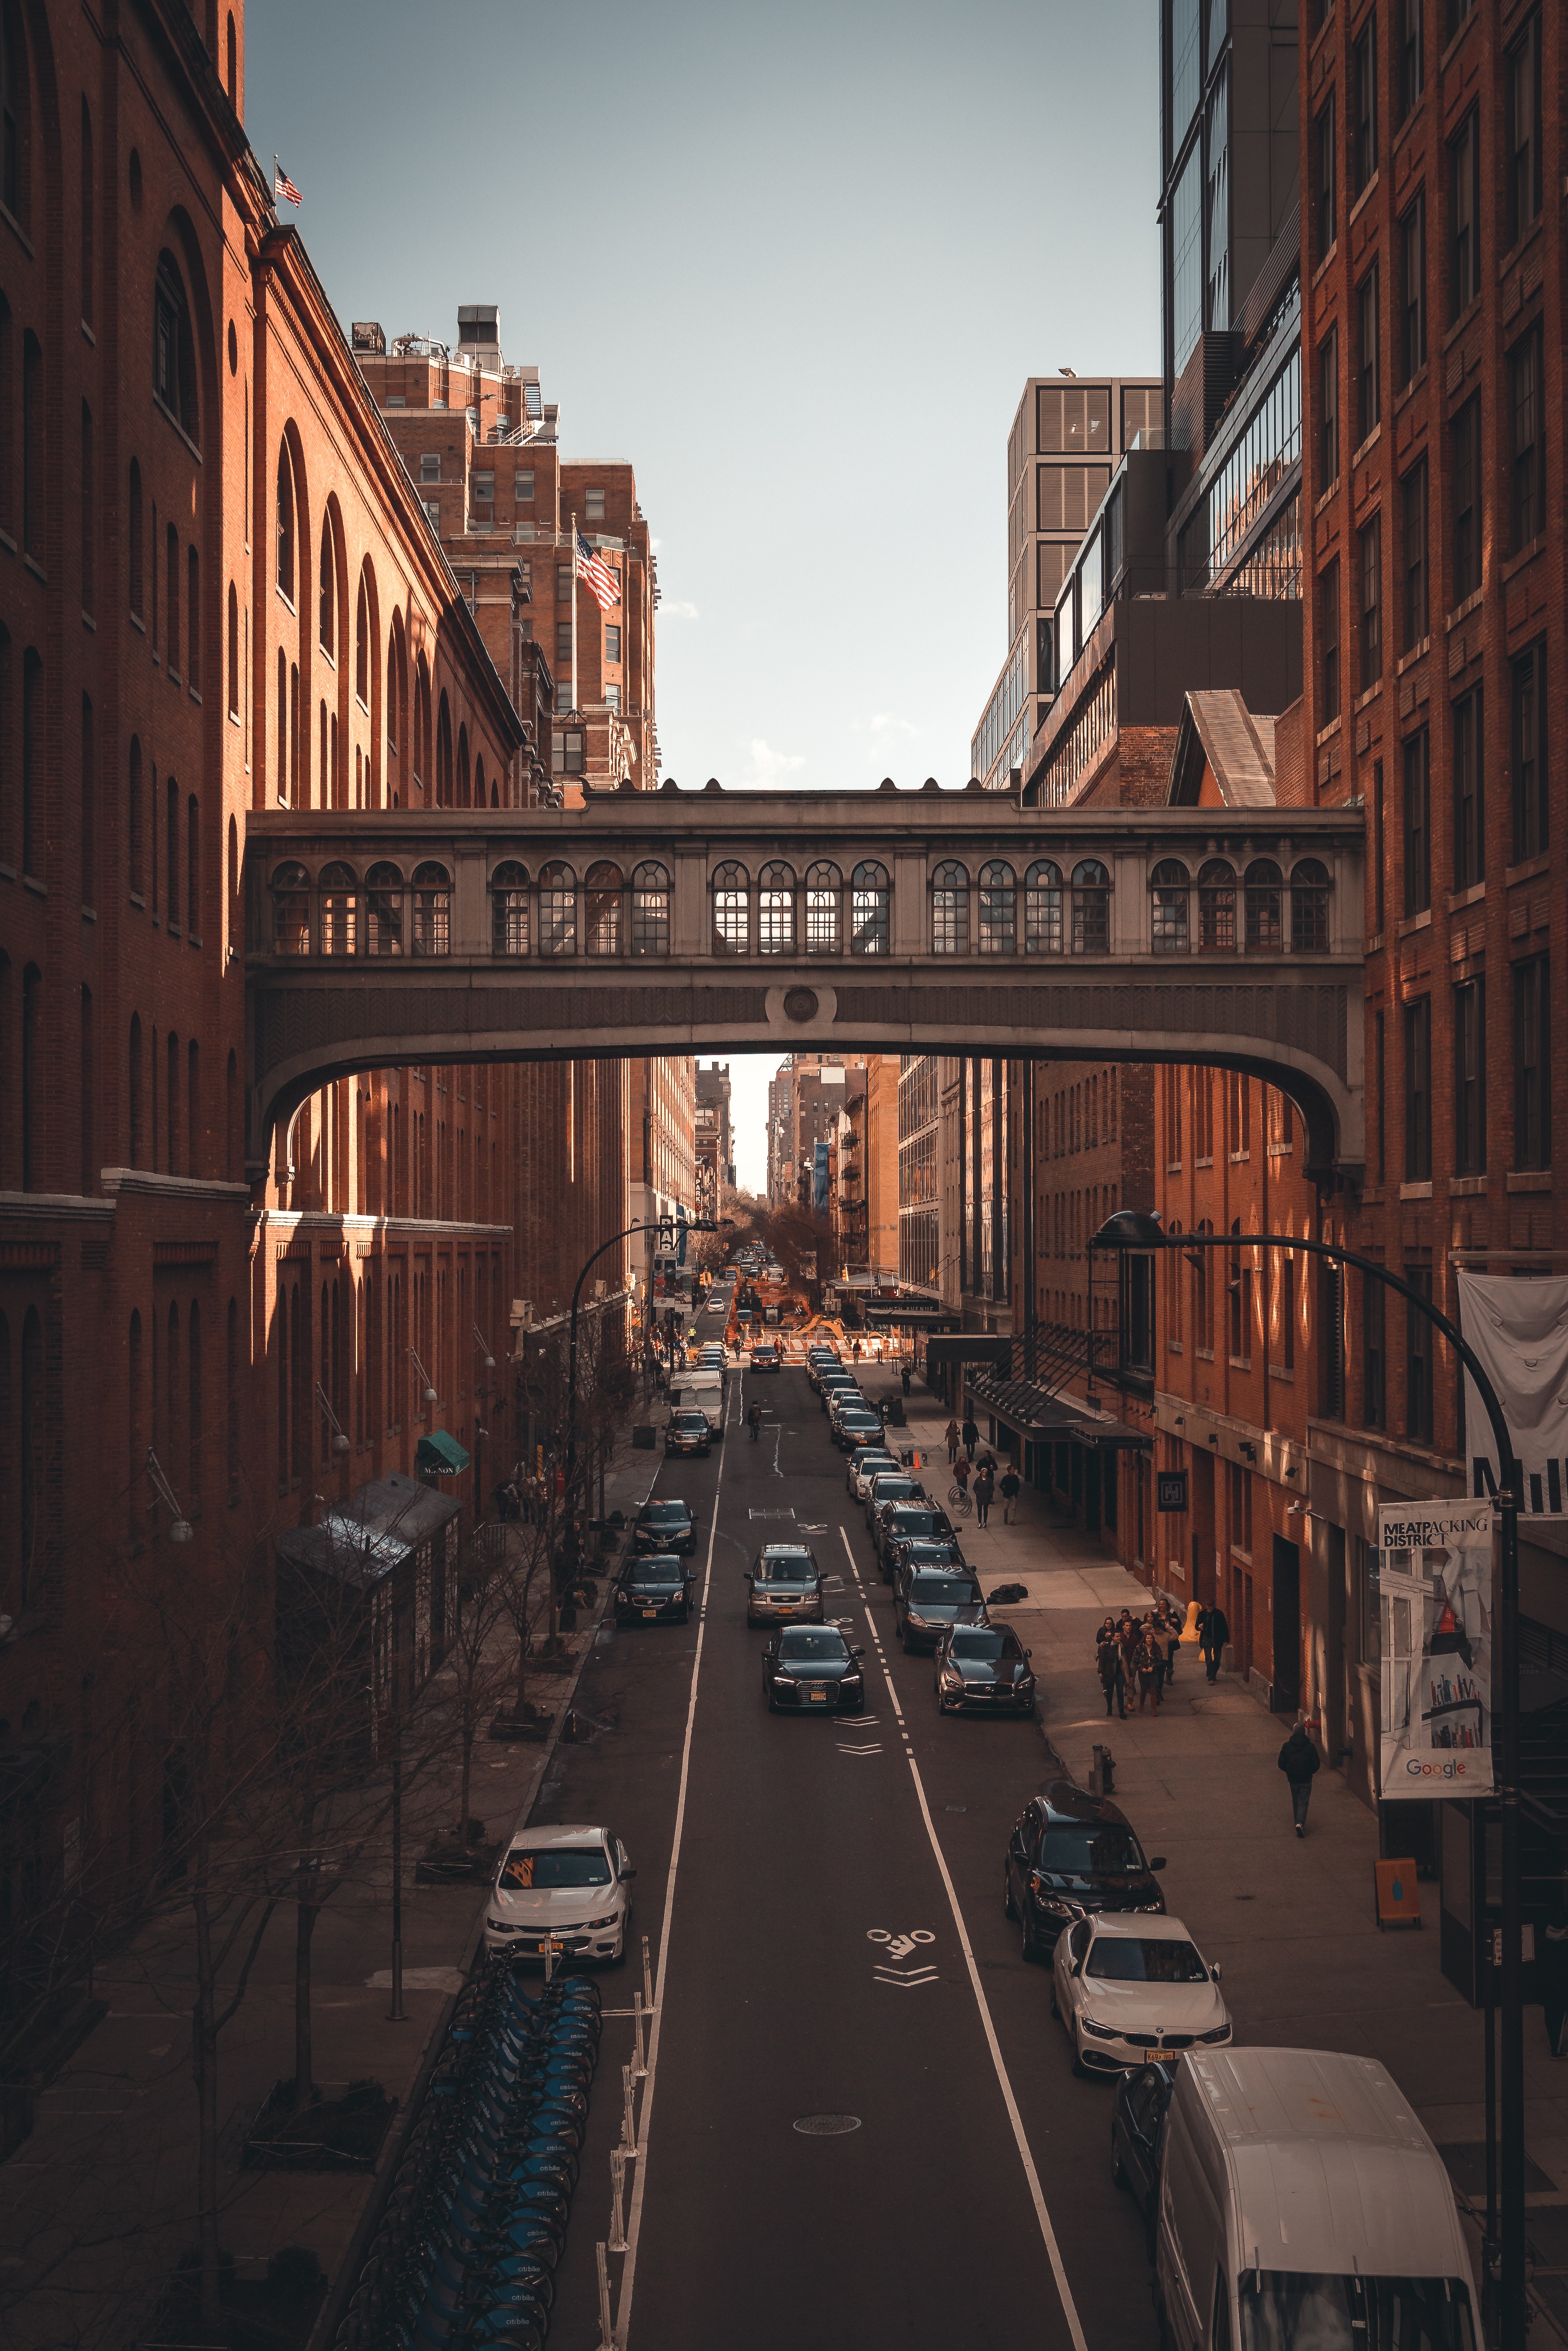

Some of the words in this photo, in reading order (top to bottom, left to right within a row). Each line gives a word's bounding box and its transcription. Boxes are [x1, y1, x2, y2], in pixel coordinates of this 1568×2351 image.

[661, 1218, 672, 1251] PAR
[1473, 1457, 1568, 1513] Mil
[1384, 1518, 1488, 1536] MEATPACKING
[1384, 1533, 1448, 1547] DISTRICT
[1406, 1758, 1466, 1779] Google
